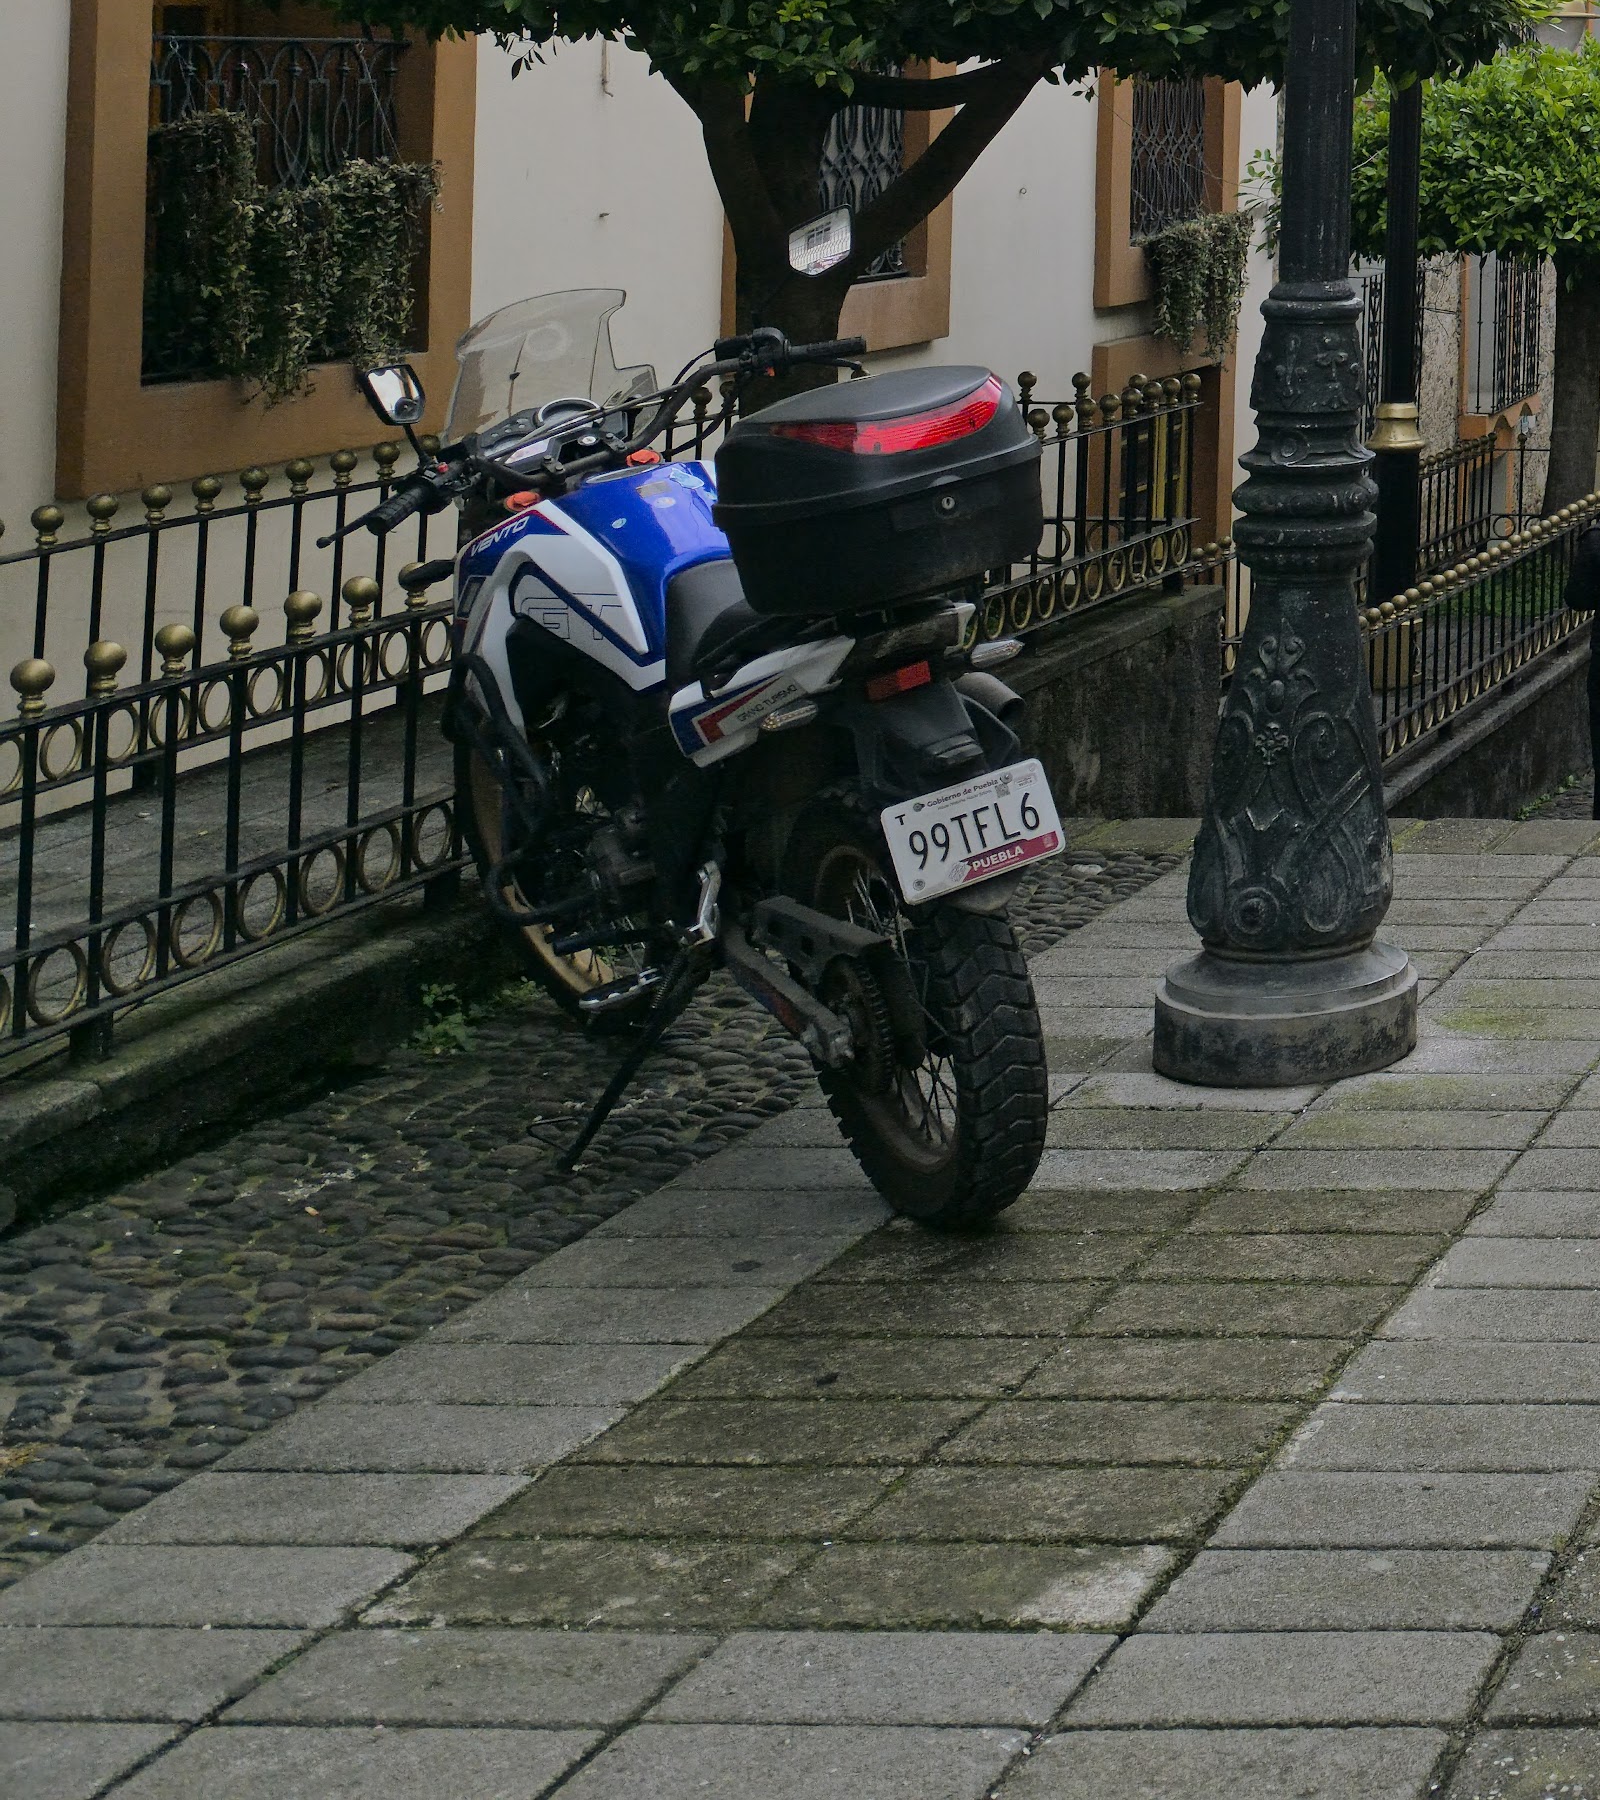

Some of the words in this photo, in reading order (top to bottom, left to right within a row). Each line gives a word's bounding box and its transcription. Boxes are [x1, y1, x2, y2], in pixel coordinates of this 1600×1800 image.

[471, 516, 530, 557] VENTO
[926, 792, 962, 808] Gobierno
[963, 788, 972, 796] de
[973, 778, 999, 792] Puebla
[908, 792, 1040, 870] 99TFL6
[972, 845, 1025, 872] PUEBLA
